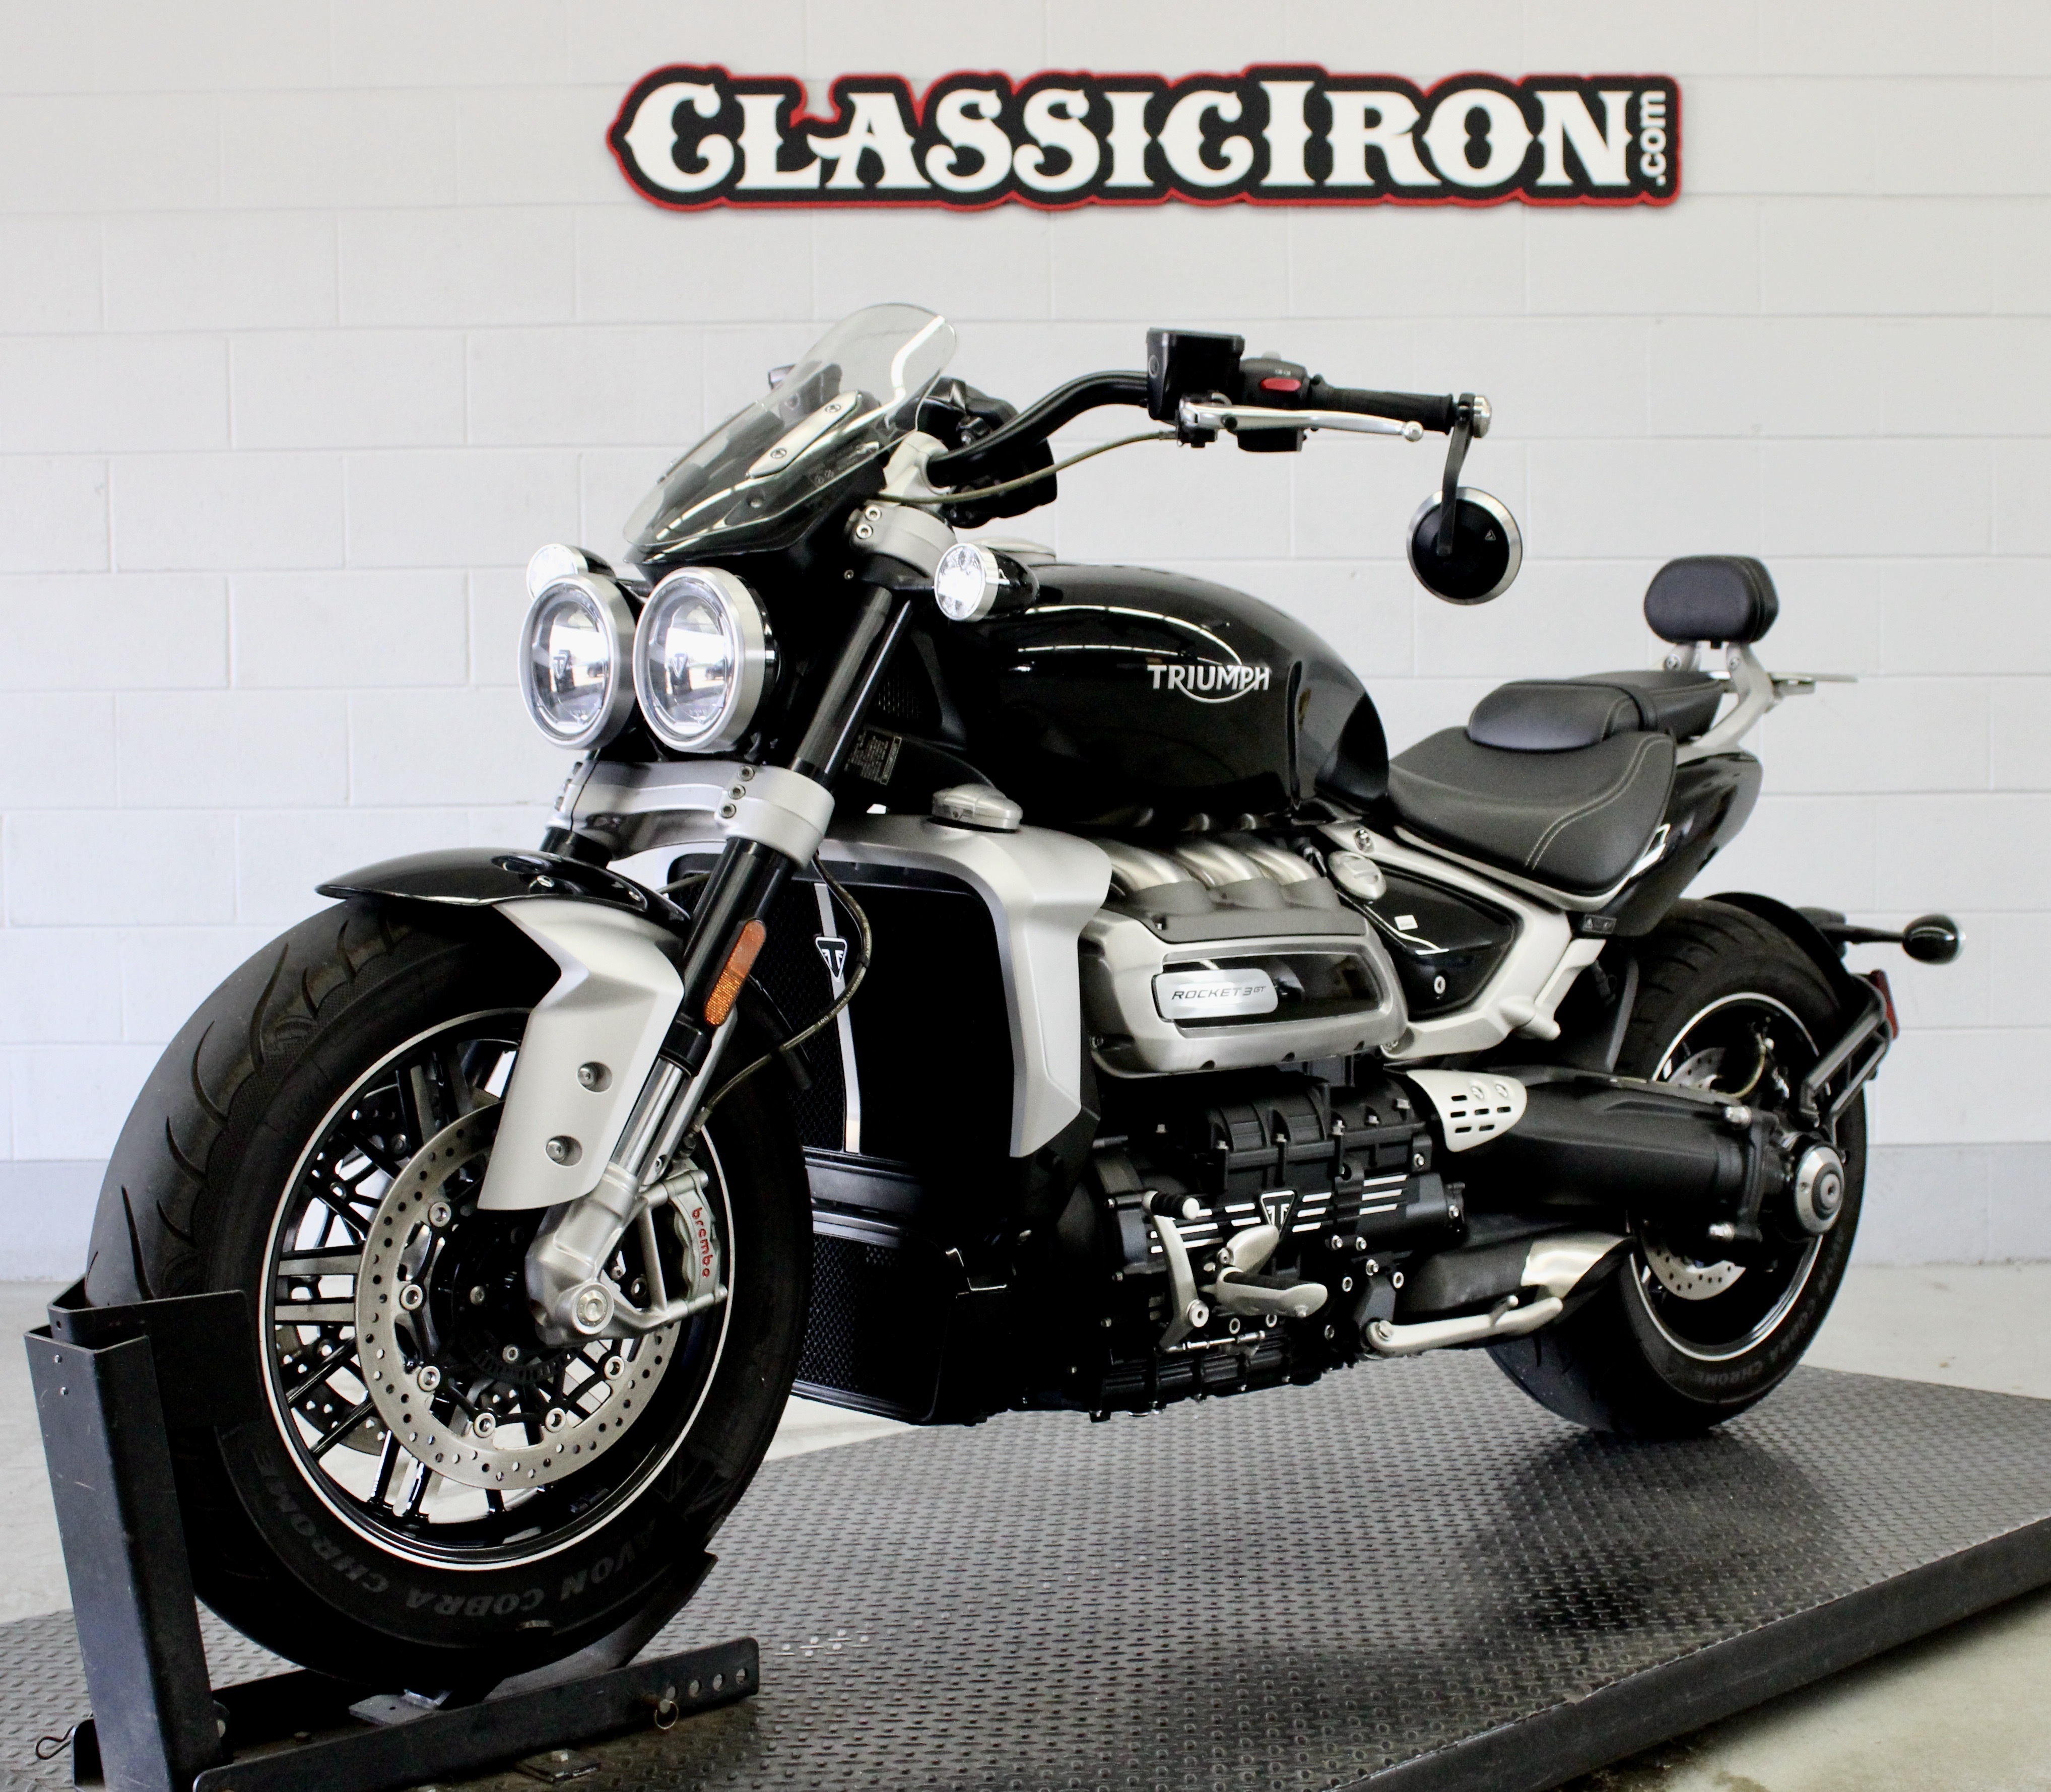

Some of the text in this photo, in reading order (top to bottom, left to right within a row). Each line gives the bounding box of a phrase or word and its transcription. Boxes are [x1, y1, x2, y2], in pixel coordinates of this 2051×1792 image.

[1640, 90, 1667, 187] .com
[1147, 665, 1270, 691] TRIUMPH
[692, 1207, 713, 1278] brembo
[406, 1587, 545, 1617] COBRA
